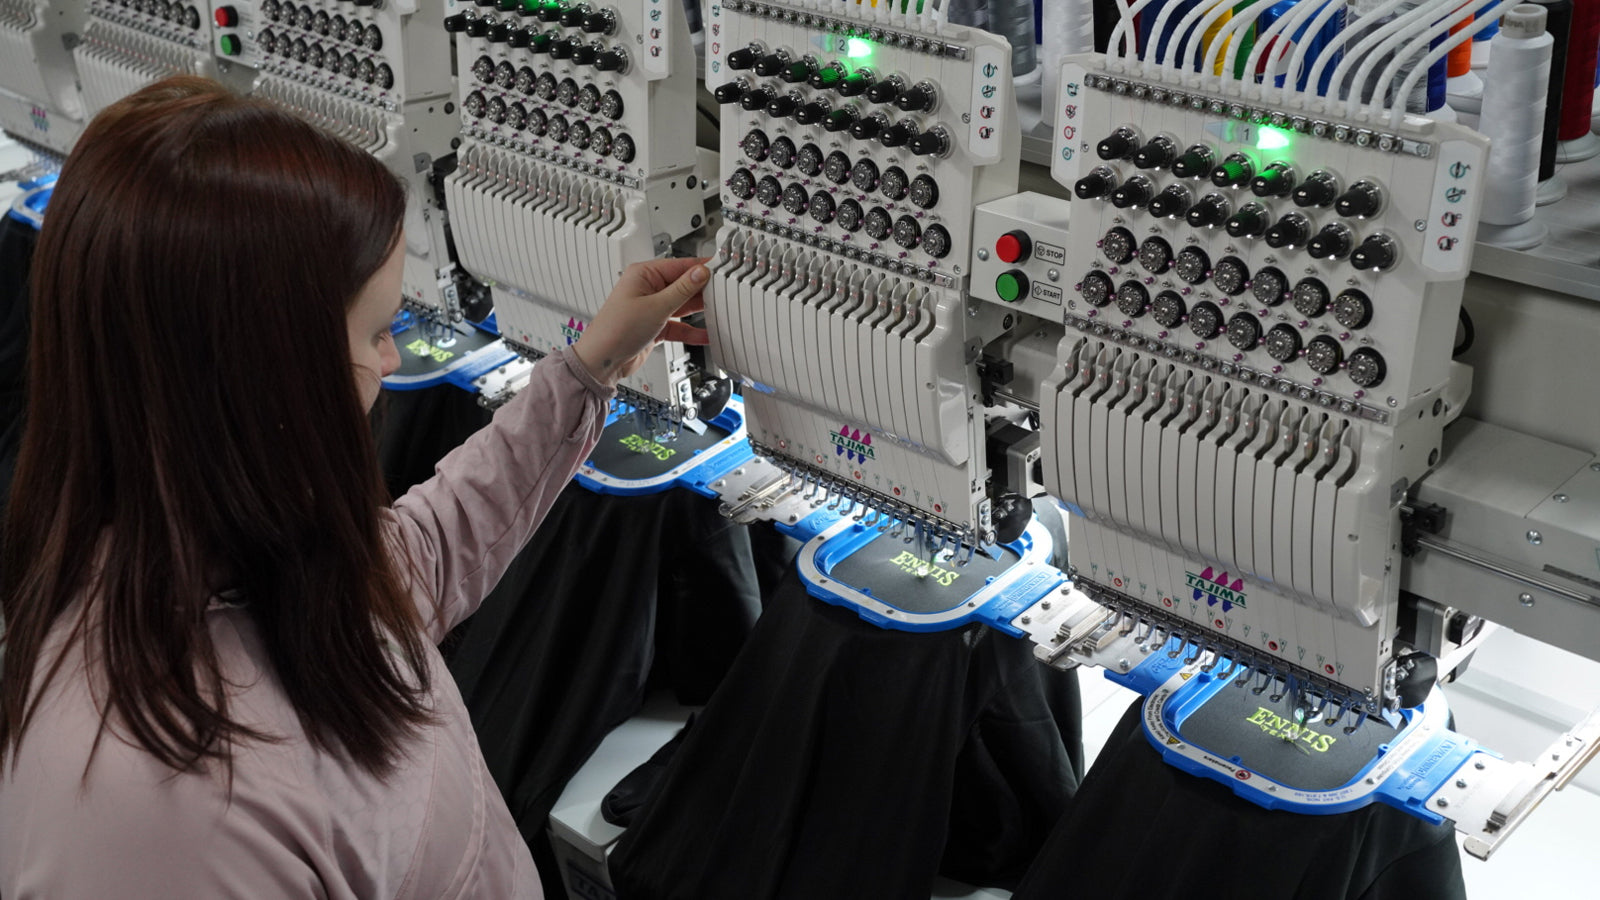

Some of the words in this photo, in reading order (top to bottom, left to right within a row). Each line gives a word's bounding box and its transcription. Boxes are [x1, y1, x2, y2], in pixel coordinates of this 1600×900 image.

[838, 38, 846, 52] 2
[1243, 127, 1250, 141] 1
[1045, 249, 1064, 260] STOP
[1043, 289, 1061, 300] START
[829, 431, 876, 458] TAJIMA
[889, 550, 961, 586] ENNIS
[1186, 573, 1247, 607] TAJIMA
[1245, 706, 1337, 752] ENNIS
